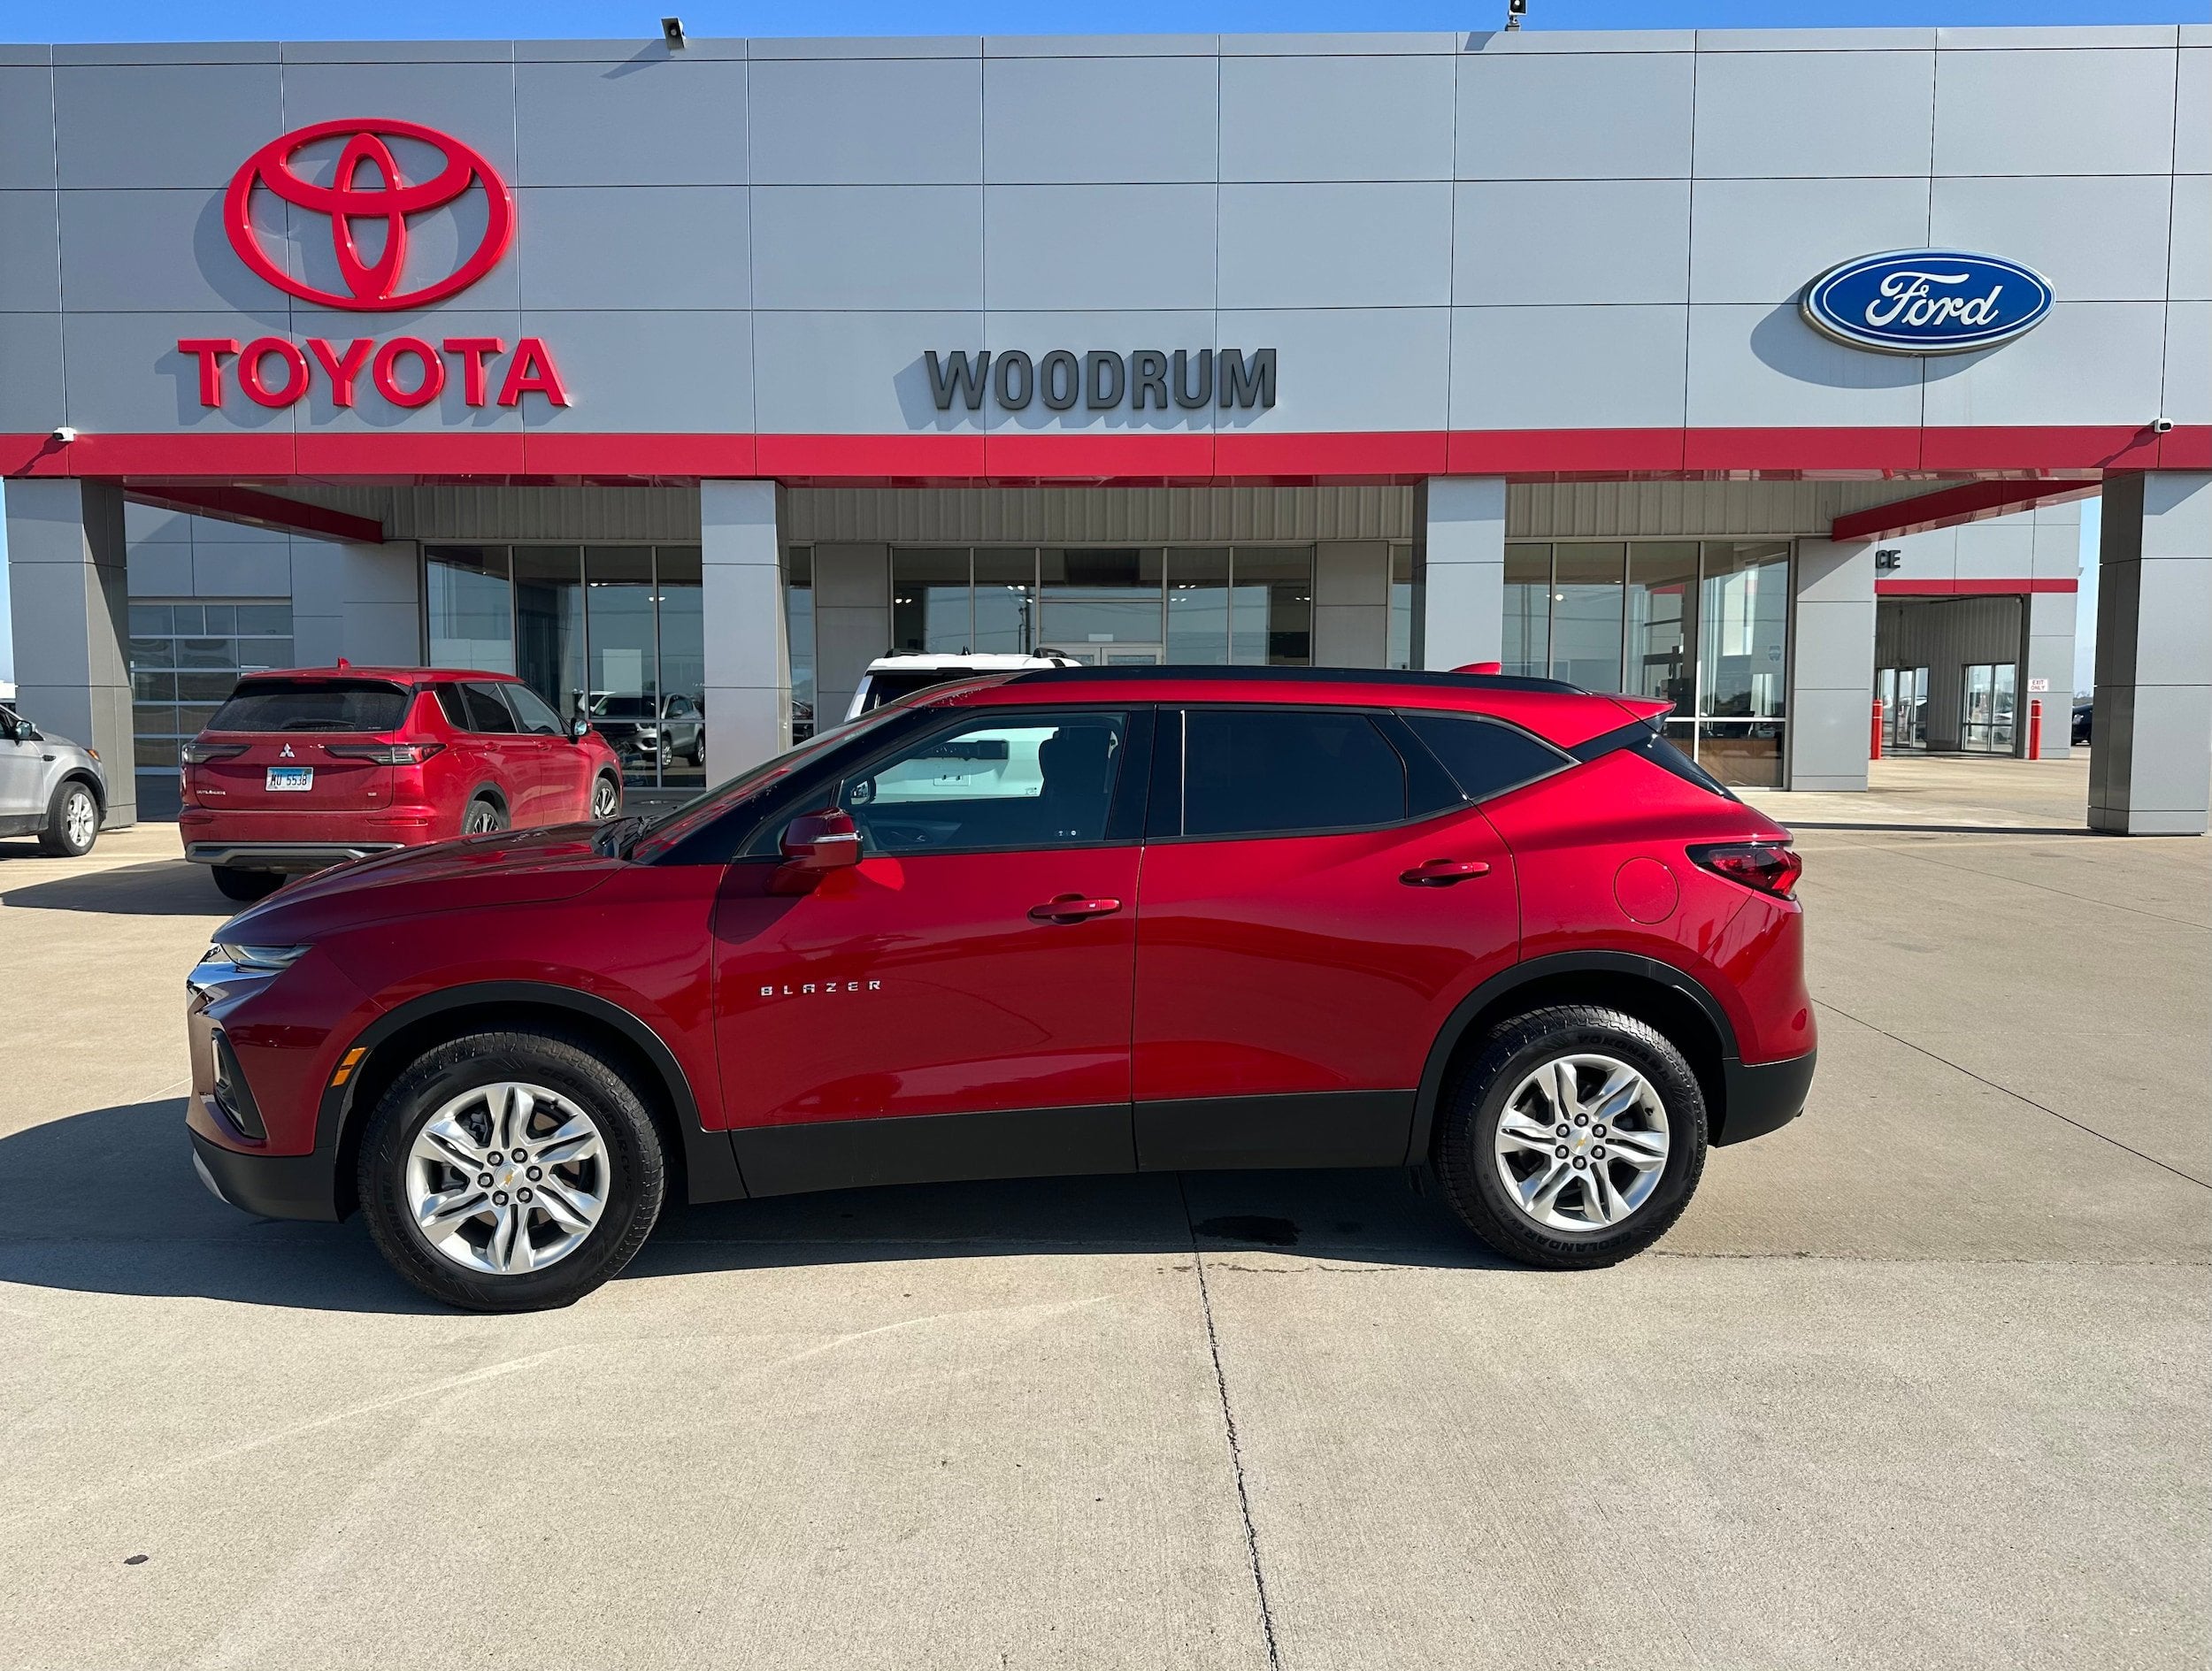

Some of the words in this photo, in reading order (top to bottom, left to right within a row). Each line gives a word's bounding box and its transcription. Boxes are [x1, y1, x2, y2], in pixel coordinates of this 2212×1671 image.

[1865, 271, 2003, 326] Ford
[178, 337, 572, 408] TOYOTA
[925, 349, 1277, 410] WOODRUM
[760, 980, 881, 996] BLAZER
[1578, 1035, 1671, 1083] YOKOHAMA
[1524, 1230, 1632, 1253] GEOLANDAR
